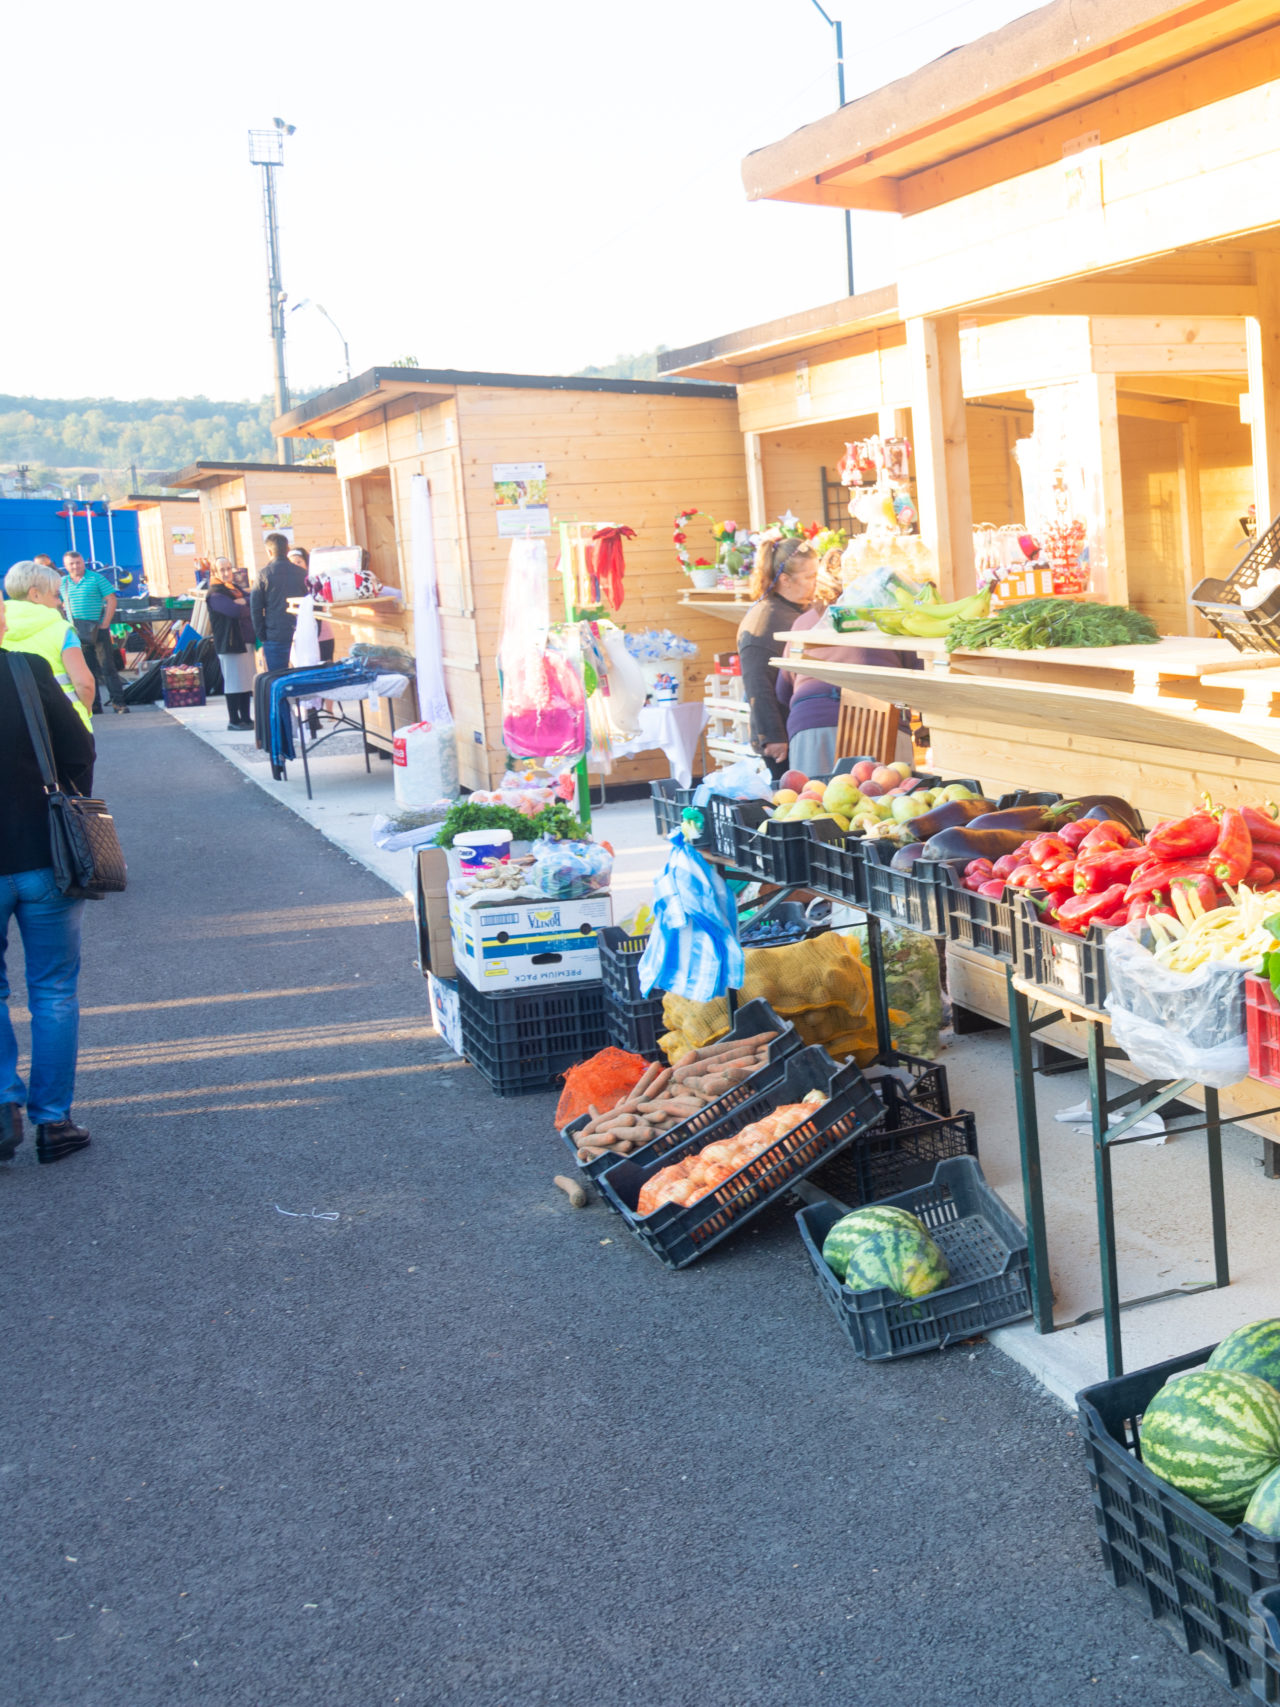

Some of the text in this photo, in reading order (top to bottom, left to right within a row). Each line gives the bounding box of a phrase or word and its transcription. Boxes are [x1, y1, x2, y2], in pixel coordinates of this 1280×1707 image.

[527, 912, 561, 928] BONITA
[514, 968, 582, 982] PREMIUM PACK
